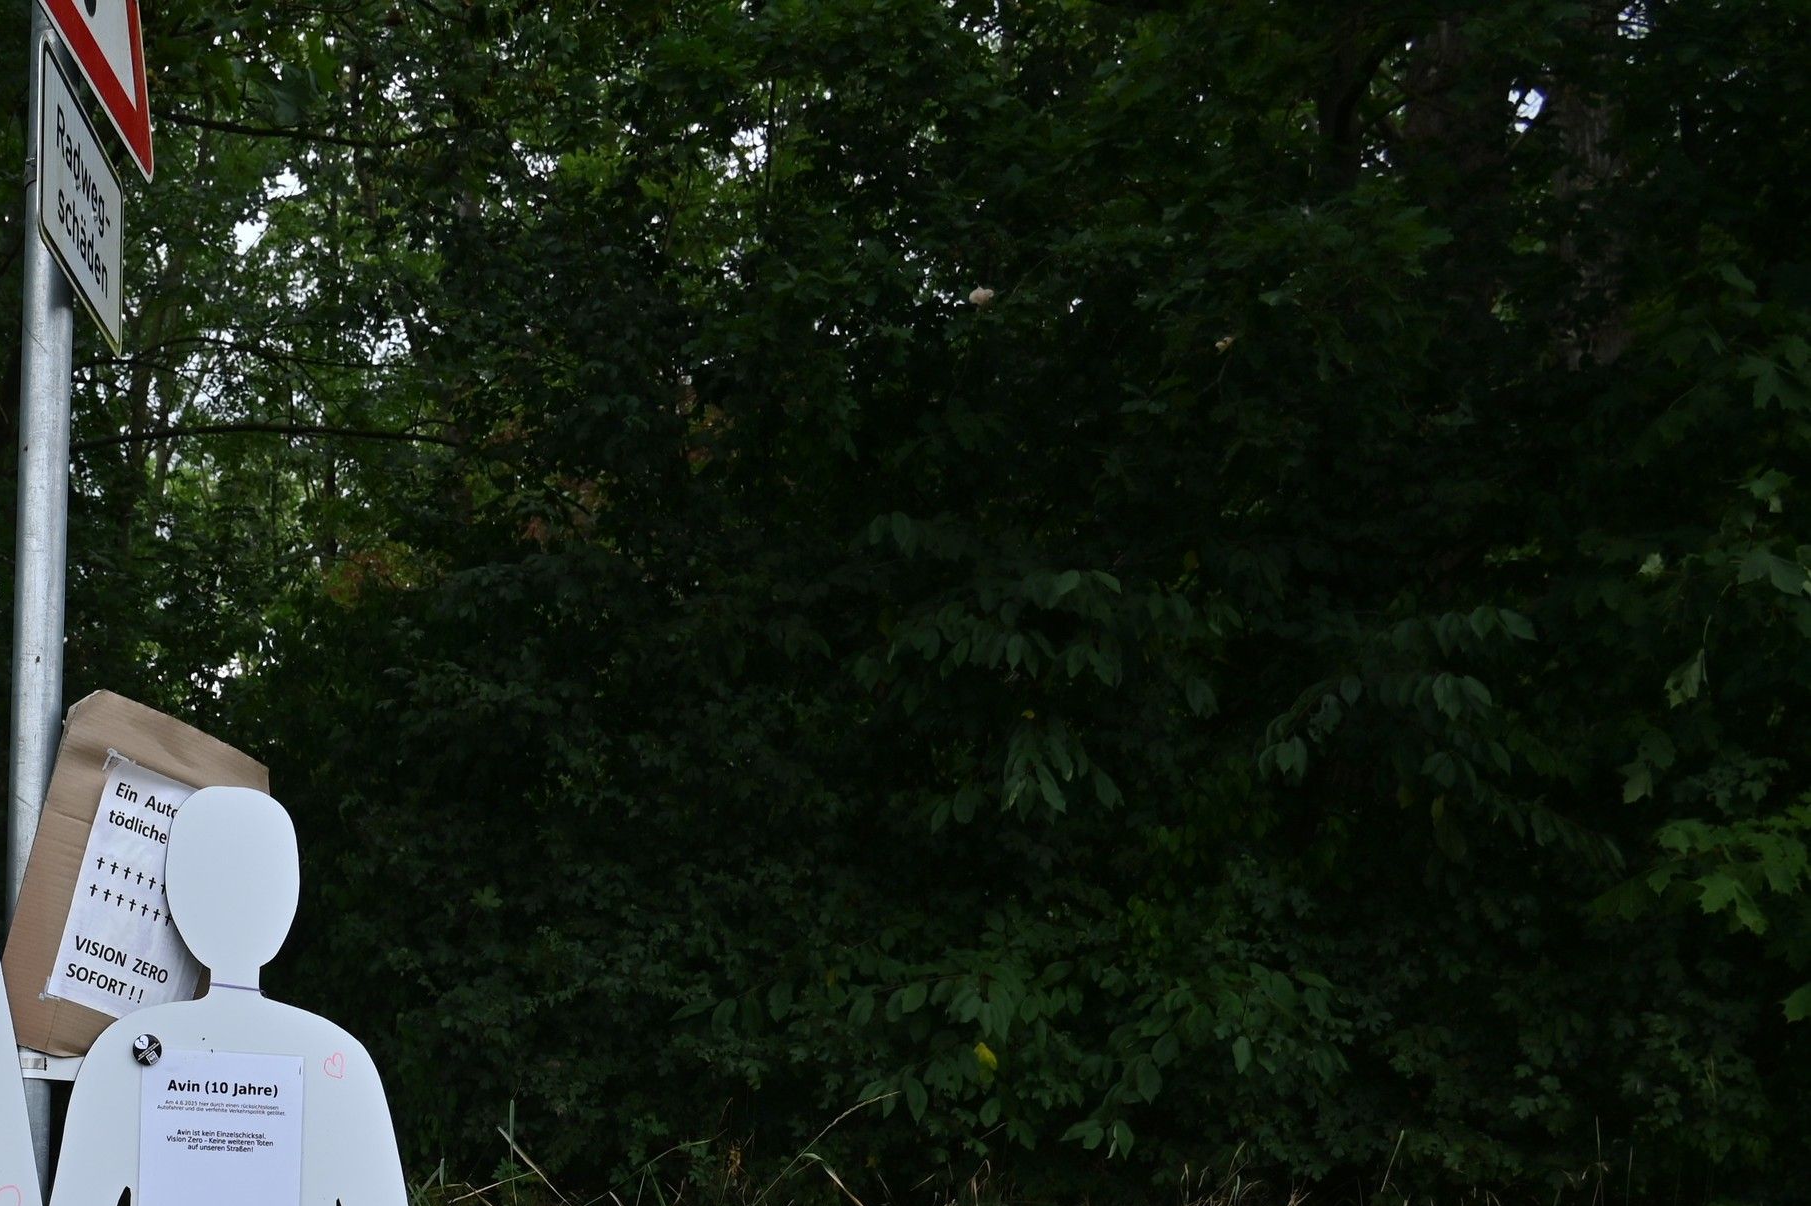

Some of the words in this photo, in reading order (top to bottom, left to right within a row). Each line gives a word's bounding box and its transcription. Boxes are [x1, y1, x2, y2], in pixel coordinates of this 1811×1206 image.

[56, 103, 111, 238] Radweg-
[57, 188, 108, 299] schäden
[115, 781, 138, 804] Ein
[108, 808, 167, 845] tödliche
[75, 935, 127, 968] VISION
[132, 957, 168, 985] ZERO
[65, 962, 127, 997] SOFORT
[168, 1079, 200, 1092] Avin
[205, 1081, 229, 1095] (10
[232, 1083, 279, 1098] Jahre)
[216, 1131, 267, 1139] Einzelschicksal.
